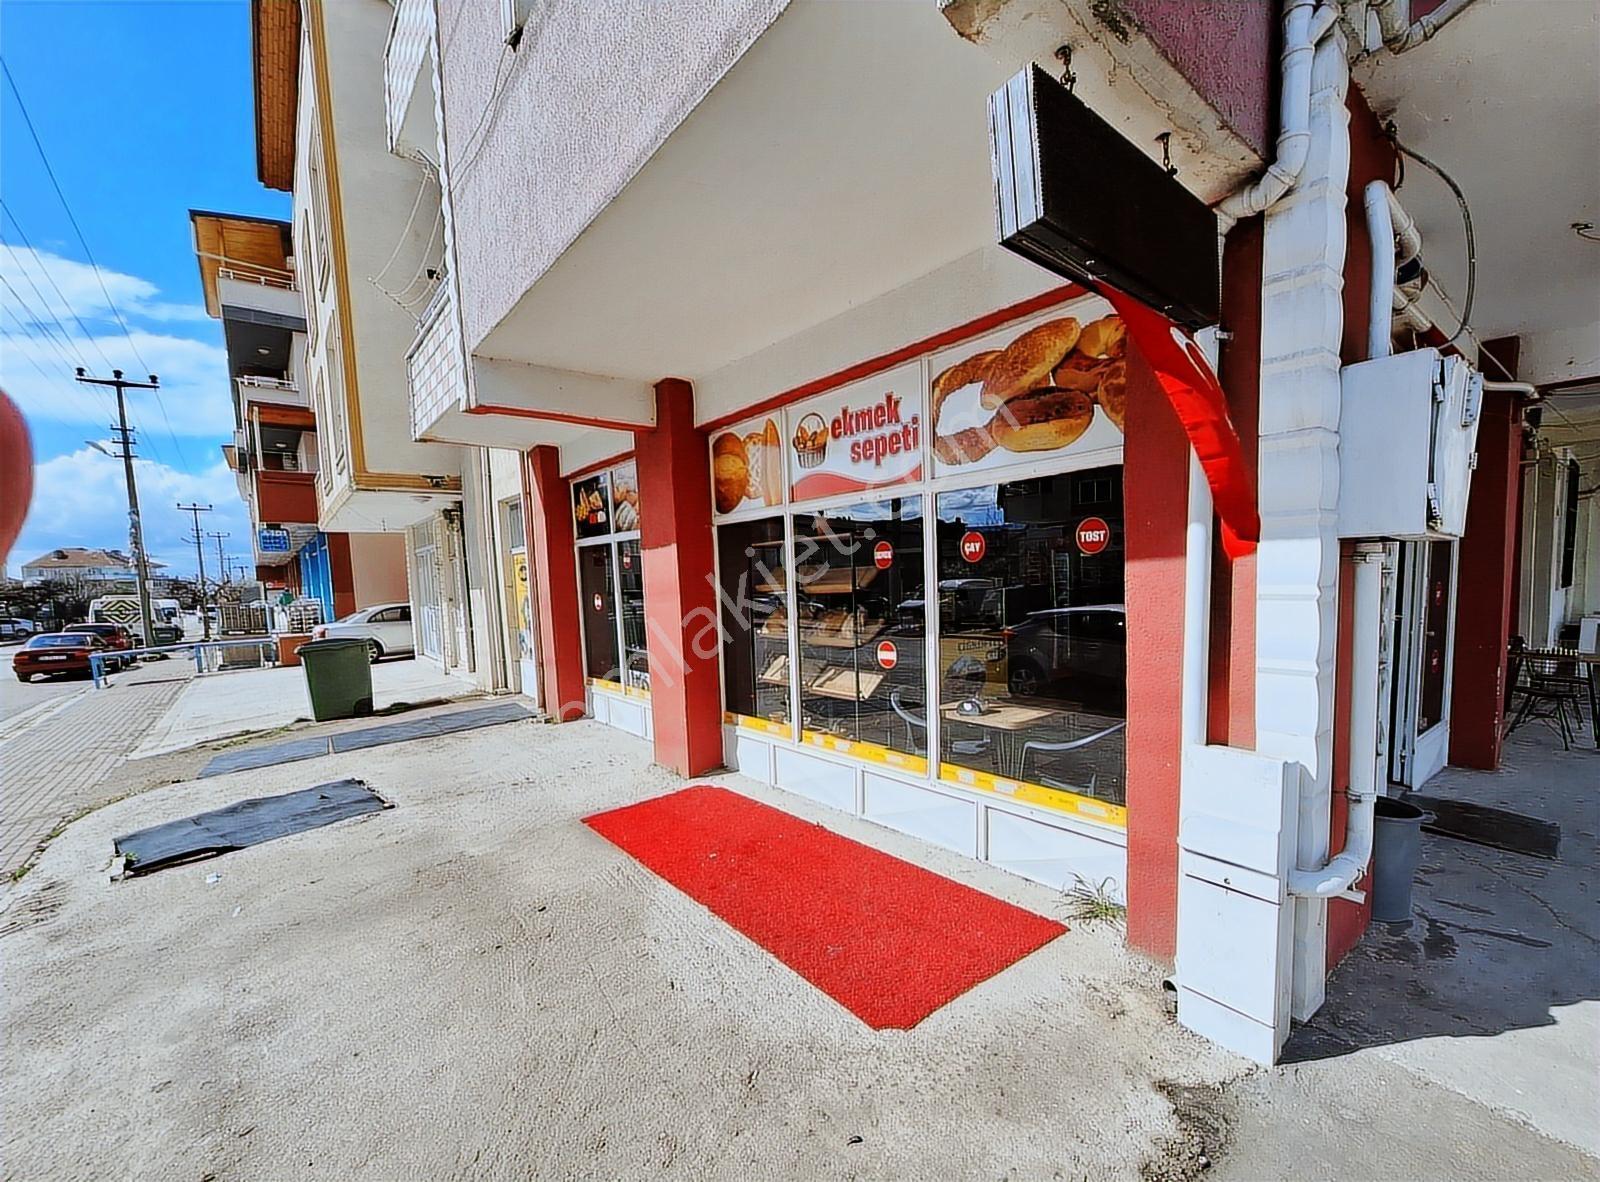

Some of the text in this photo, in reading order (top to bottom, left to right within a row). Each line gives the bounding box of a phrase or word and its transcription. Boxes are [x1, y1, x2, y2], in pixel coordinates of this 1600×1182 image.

[830, 391, 902, 440] ekmek
[850, 414, 919, 467] sepeti
[1079, 530, 1106, 543] TOST
